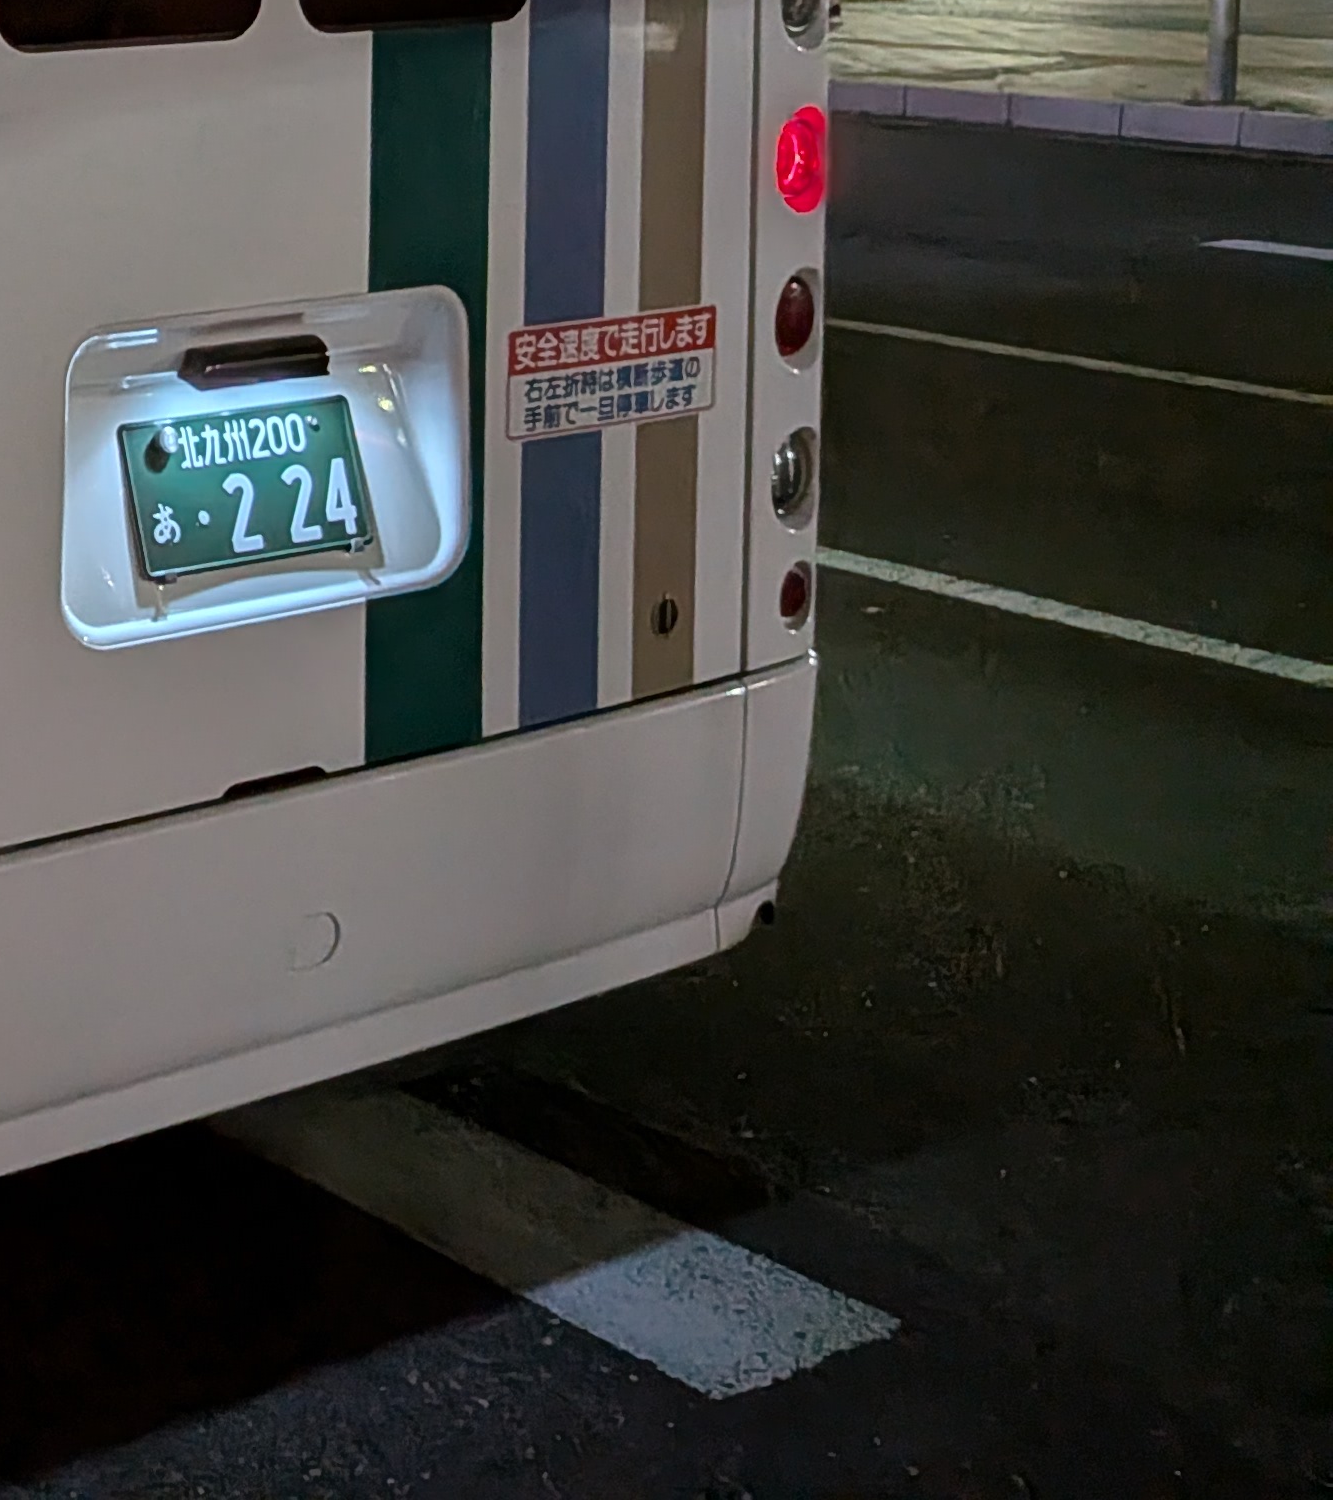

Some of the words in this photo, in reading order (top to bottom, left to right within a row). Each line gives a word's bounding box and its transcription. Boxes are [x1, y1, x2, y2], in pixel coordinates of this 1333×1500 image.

[513, 311, 712, 372] 安全速度で走行します
[177, 412, 307, 470] 北九州200
[152, 503, 182, 545] あ
